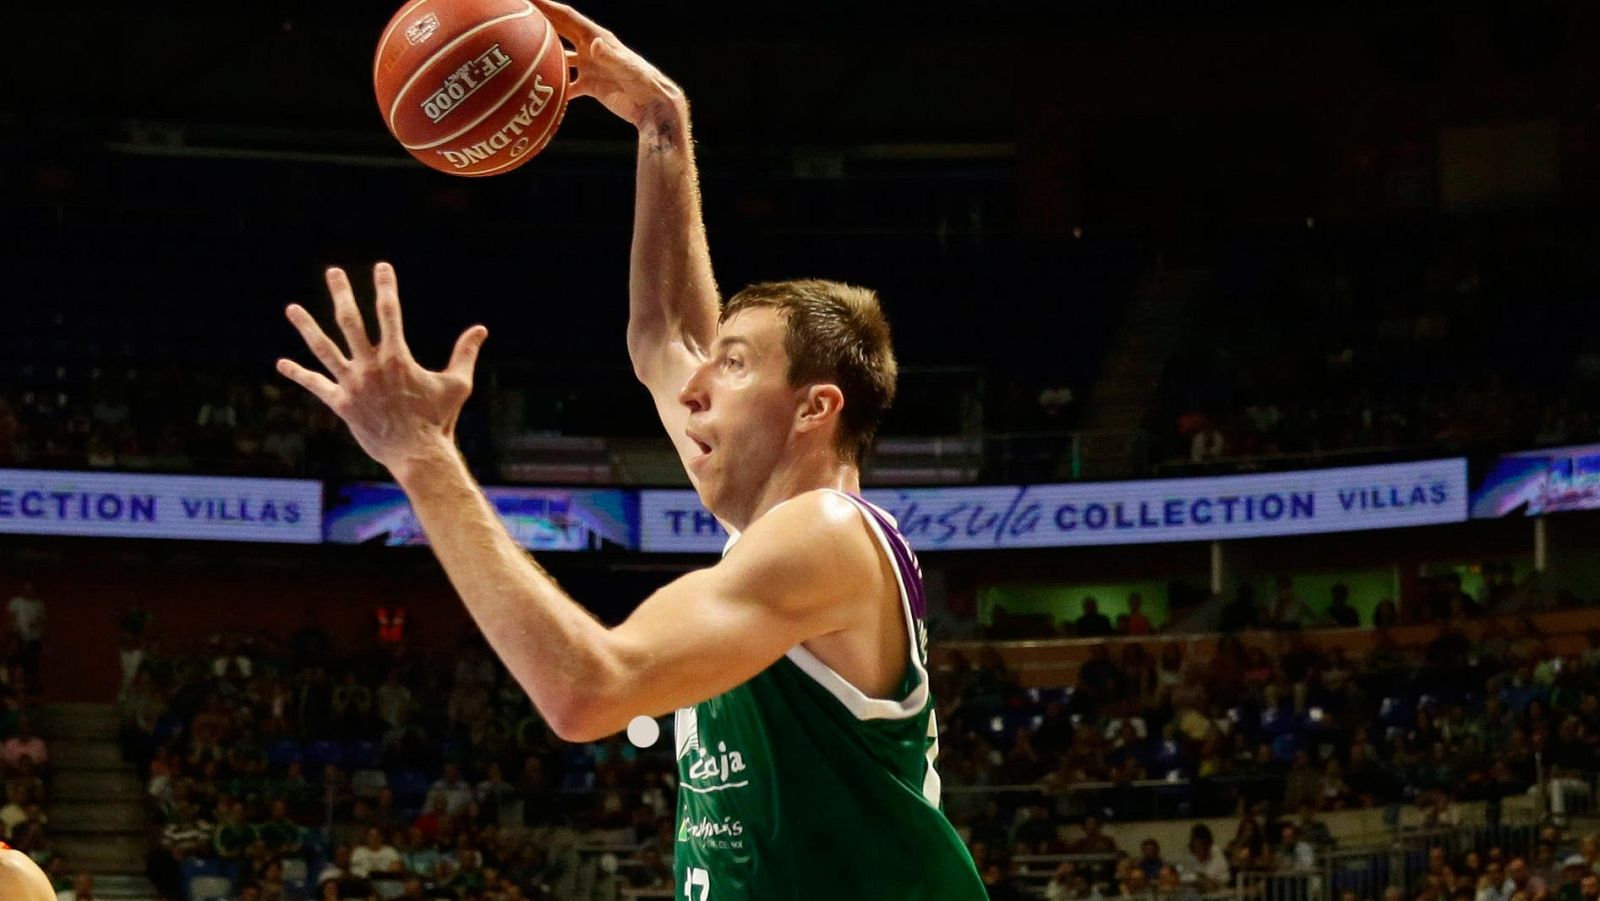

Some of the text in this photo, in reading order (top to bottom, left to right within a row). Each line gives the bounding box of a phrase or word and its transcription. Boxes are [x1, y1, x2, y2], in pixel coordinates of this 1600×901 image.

[442, 74, 554, 169] SPALDING
[181, 497, 301, 523] VILLAS
[664, 510, 728, 535] TH
[1054, 492, 1315, 531] COLLECTION
[1338, 484, 1447, 511] VILLAS
